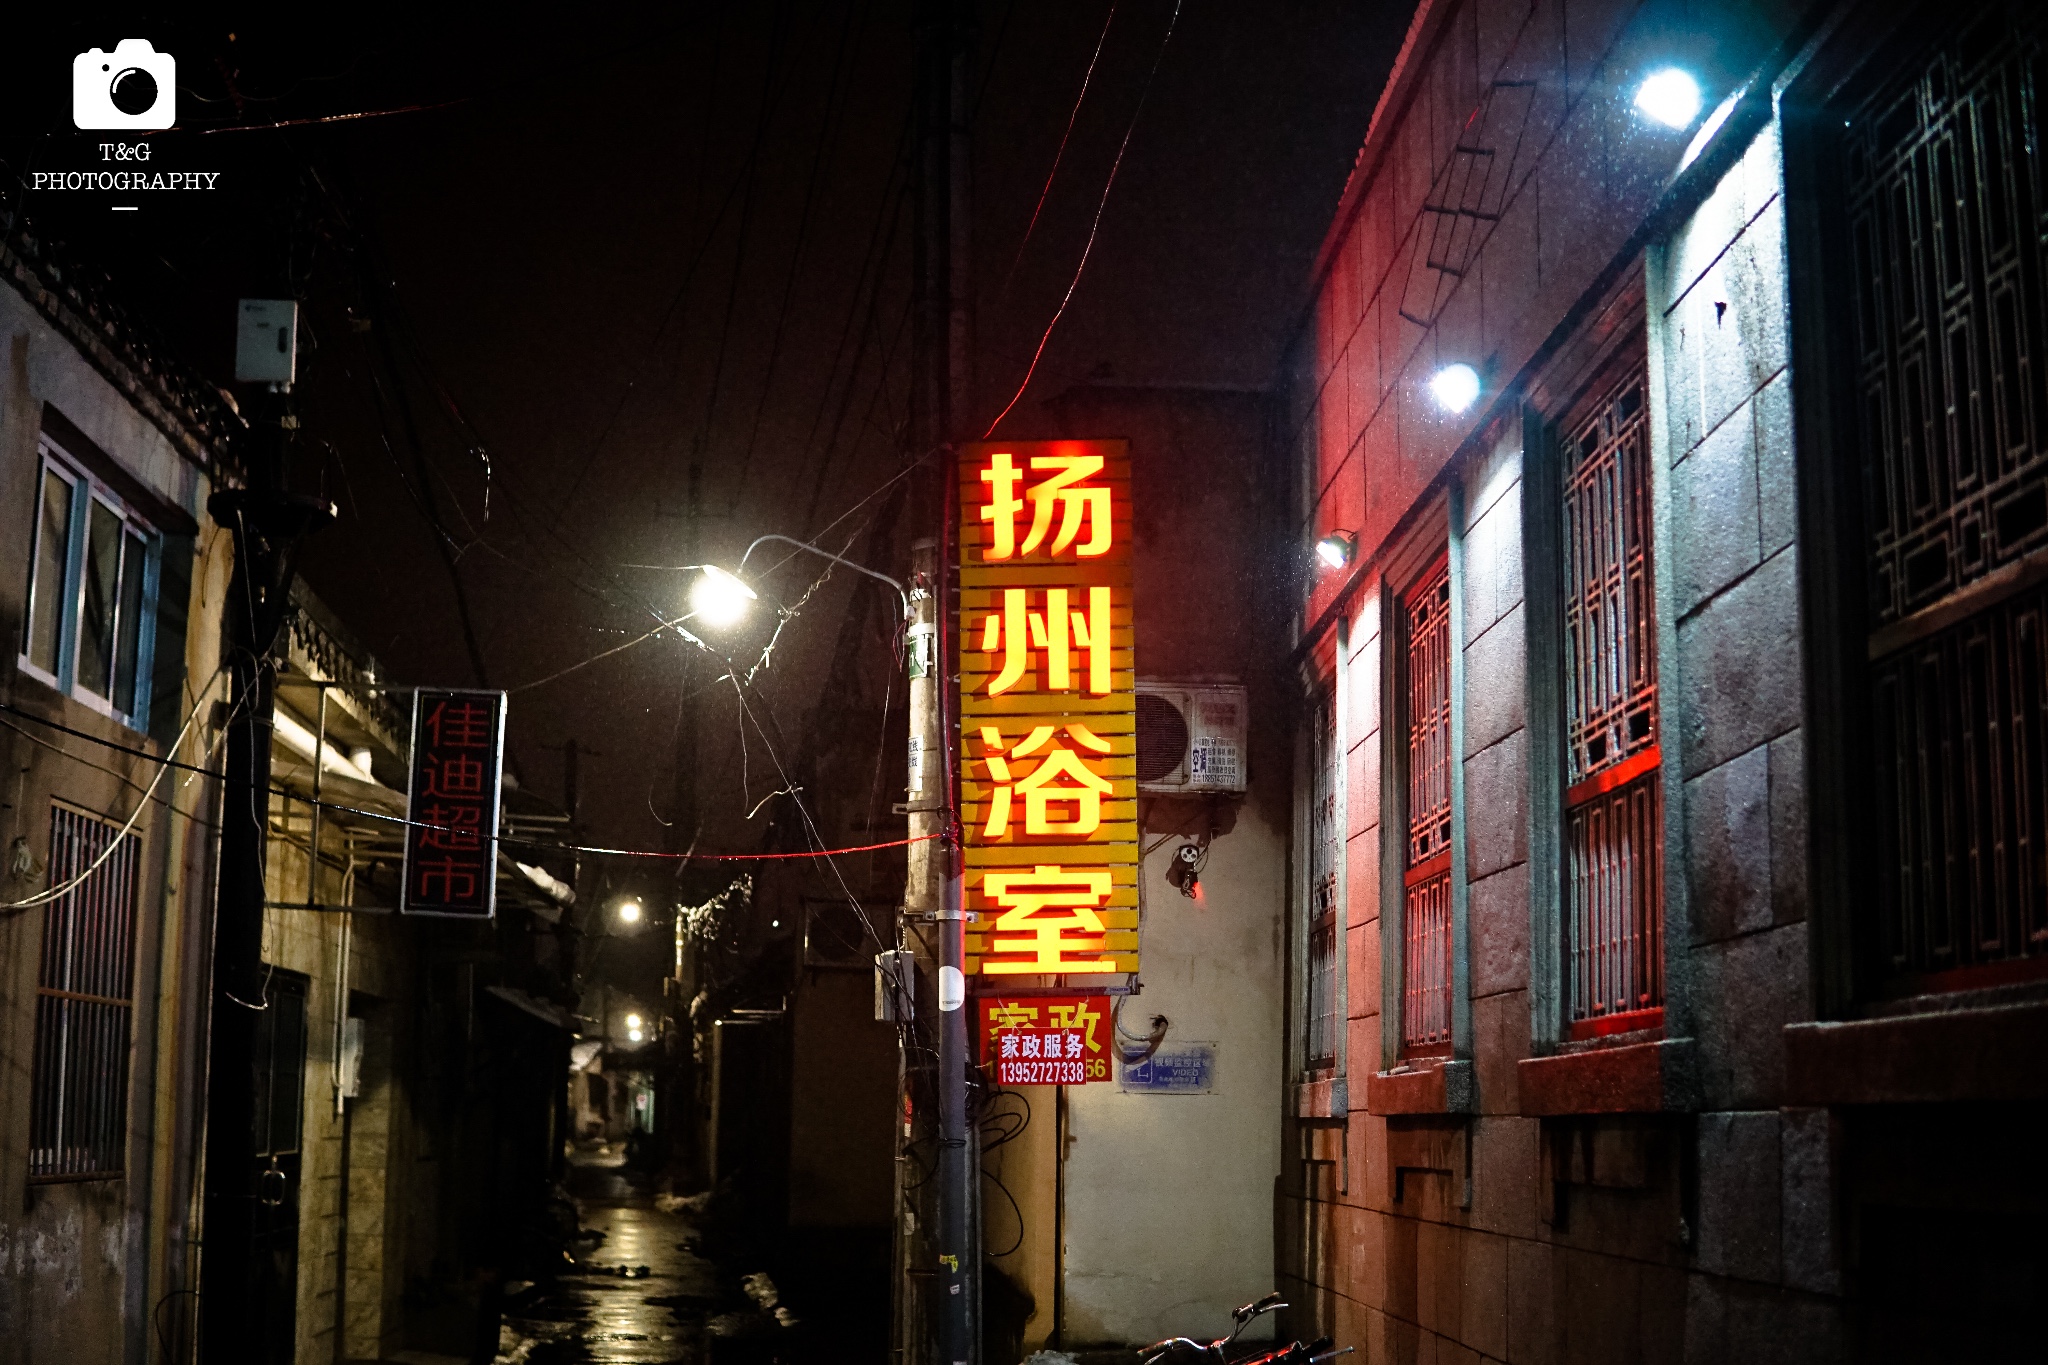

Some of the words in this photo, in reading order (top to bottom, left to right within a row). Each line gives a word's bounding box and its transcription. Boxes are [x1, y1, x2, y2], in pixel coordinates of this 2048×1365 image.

[980, 453, 1116, 974] 扬州浴室
[418, 701, 489, 903] 佳迪超市
[1001, 1033, 1084, 1060] 家政服务
[1001, 1062, 1084, 1083] 13952727338
[1172, 1068, 1199, 1077] VIDEO
